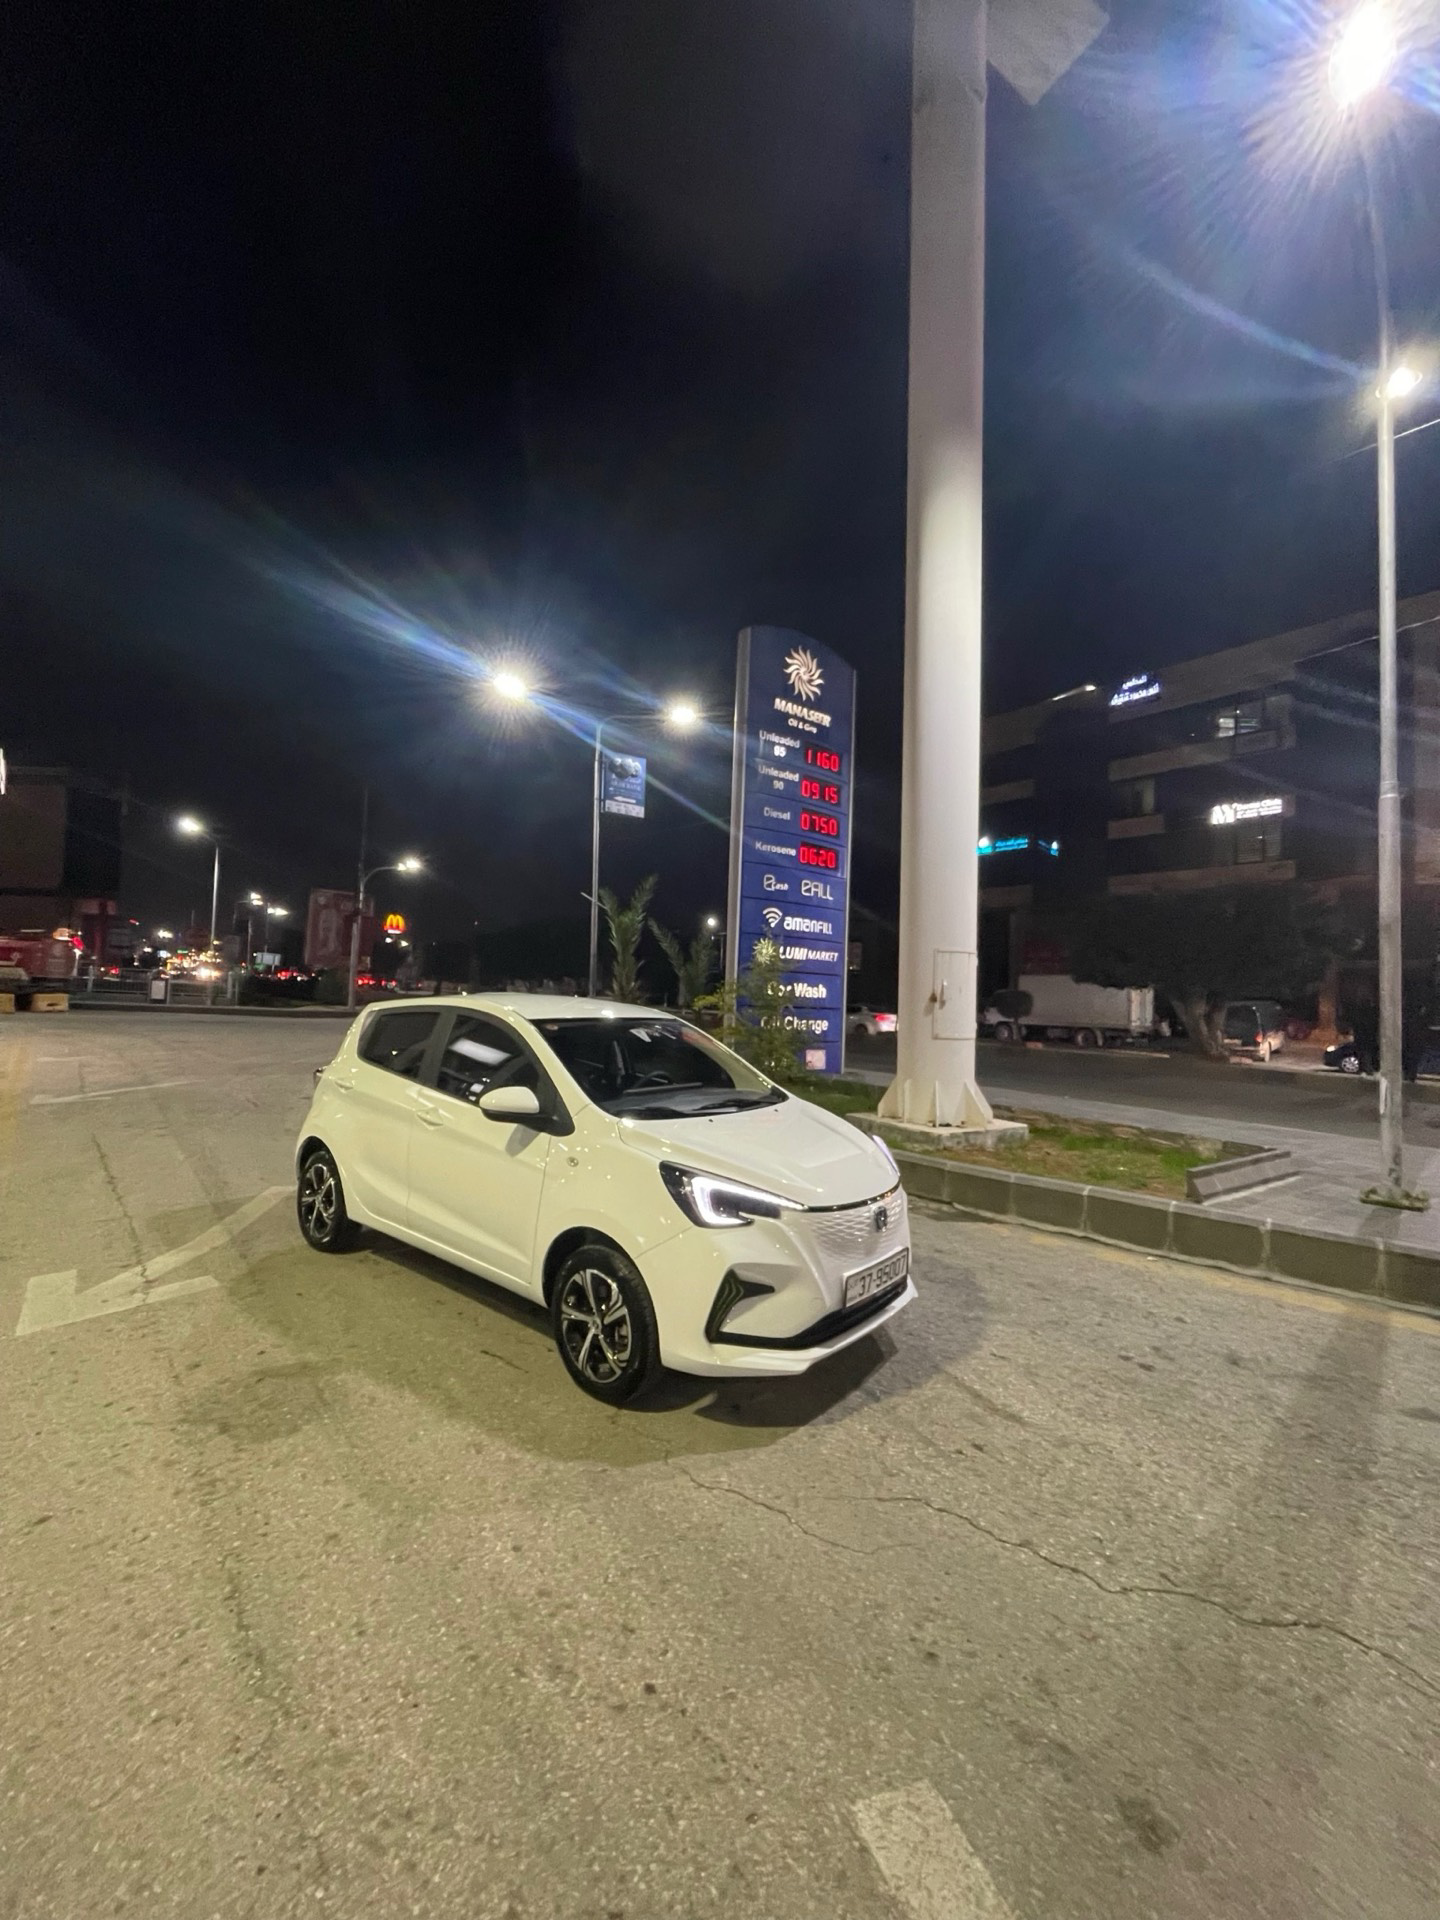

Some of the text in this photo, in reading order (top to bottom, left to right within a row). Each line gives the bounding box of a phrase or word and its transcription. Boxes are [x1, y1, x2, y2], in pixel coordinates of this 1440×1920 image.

[759, 730, 800, 749] Unleaded
[758, 765, 800, 782] Unleaded
[773, 780, 784, 790] 90
[763, 806, 791, 820] Diesel
[755, 841, 796, 857] Kerosene
[779, 945, 839, 962] LUMI MARKET
[793, 982, 827, 999] Wash
[784, 1015, 829, 1035] Change
